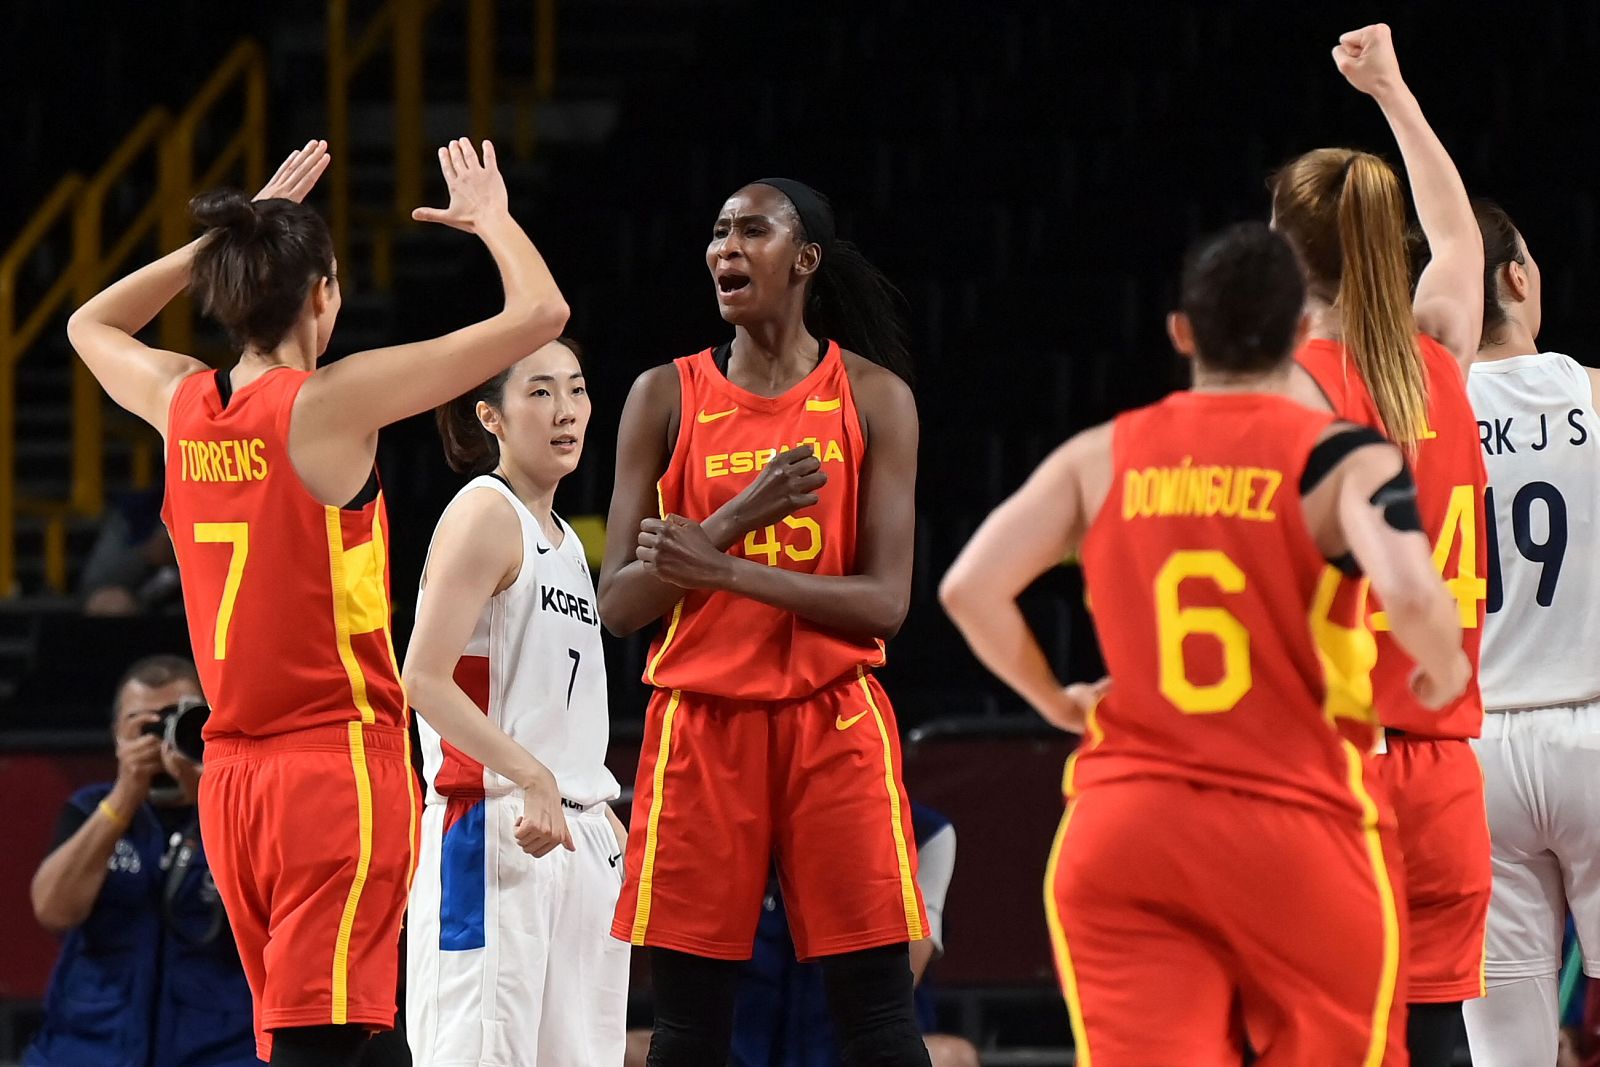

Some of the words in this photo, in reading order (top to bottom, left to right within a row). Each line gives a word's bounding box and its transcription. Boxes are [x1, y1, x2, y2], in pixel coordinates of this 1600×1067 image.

[178, 437, 269, 483] TORRENS
[705, 437, 845, 478] ESPÑA
[1531, 413, 1548, 451] J
[1567, 408, 1588, 446] S
[1122, 454, 1283, 522] DOMÍNGUEZ
[744, 514, 822, 567] 45
[1485, 480, 1568, 614] 19
[193, 522, 249, 661] 7
[1154, 549, 1253, 715] 6
[566, 647, 581, 712] 7
